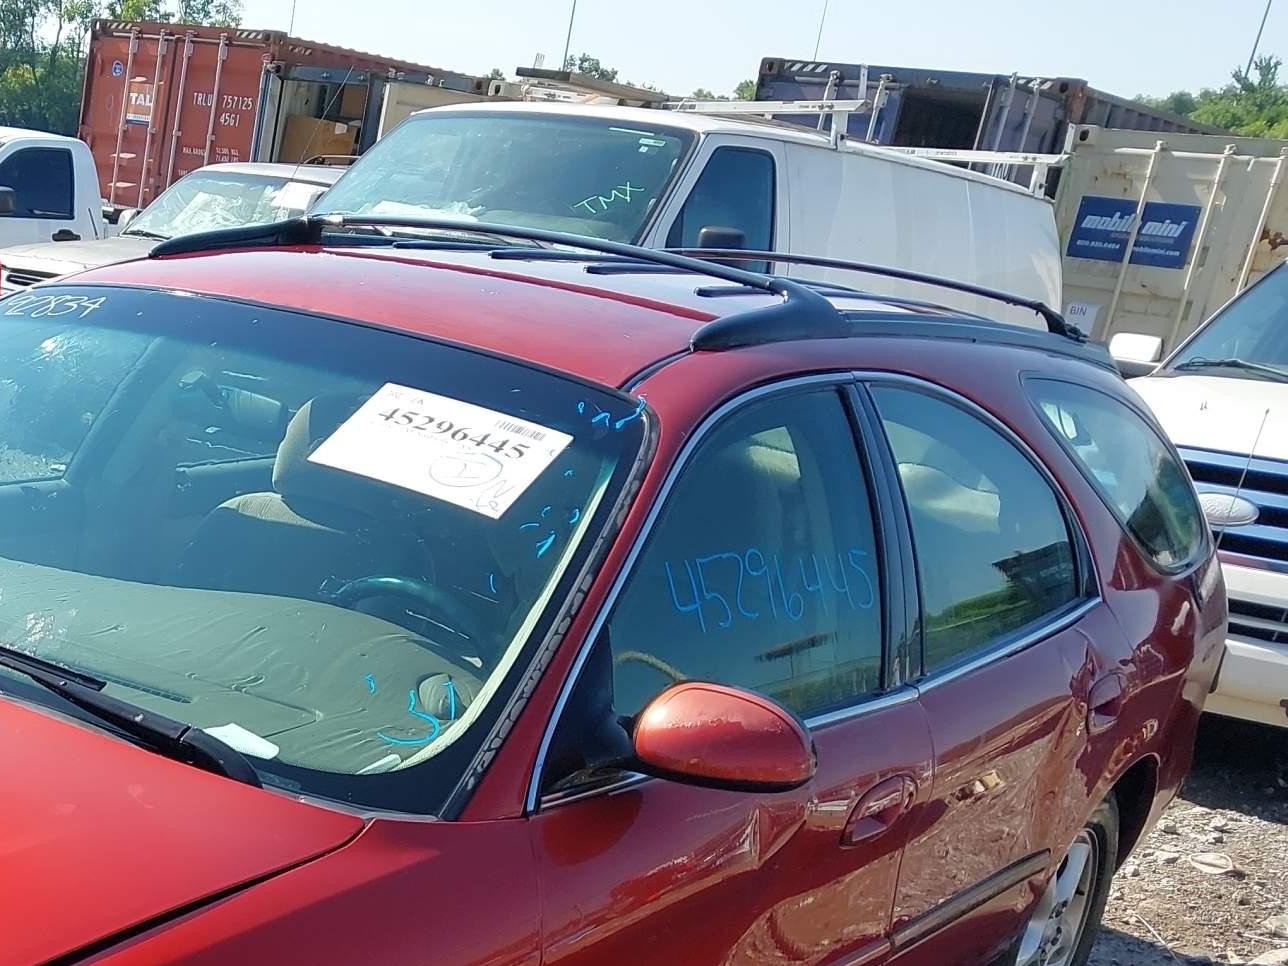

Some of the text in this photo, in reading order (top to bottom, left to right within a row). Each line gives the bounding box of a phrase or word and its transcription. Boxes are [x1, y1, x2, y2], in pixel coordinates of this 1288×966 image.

[130, 93, 153, 107] TAL
[193, 92, 253, 110] TRLU 757125
[220, 113, 240, 127] 45G1
[1141, 219, 1189, 238] mini
[1070, 305, 1088, 317] BIN
[377, 406, 532, 460] 45296445
[665, 548, 875, 633] 45296445
